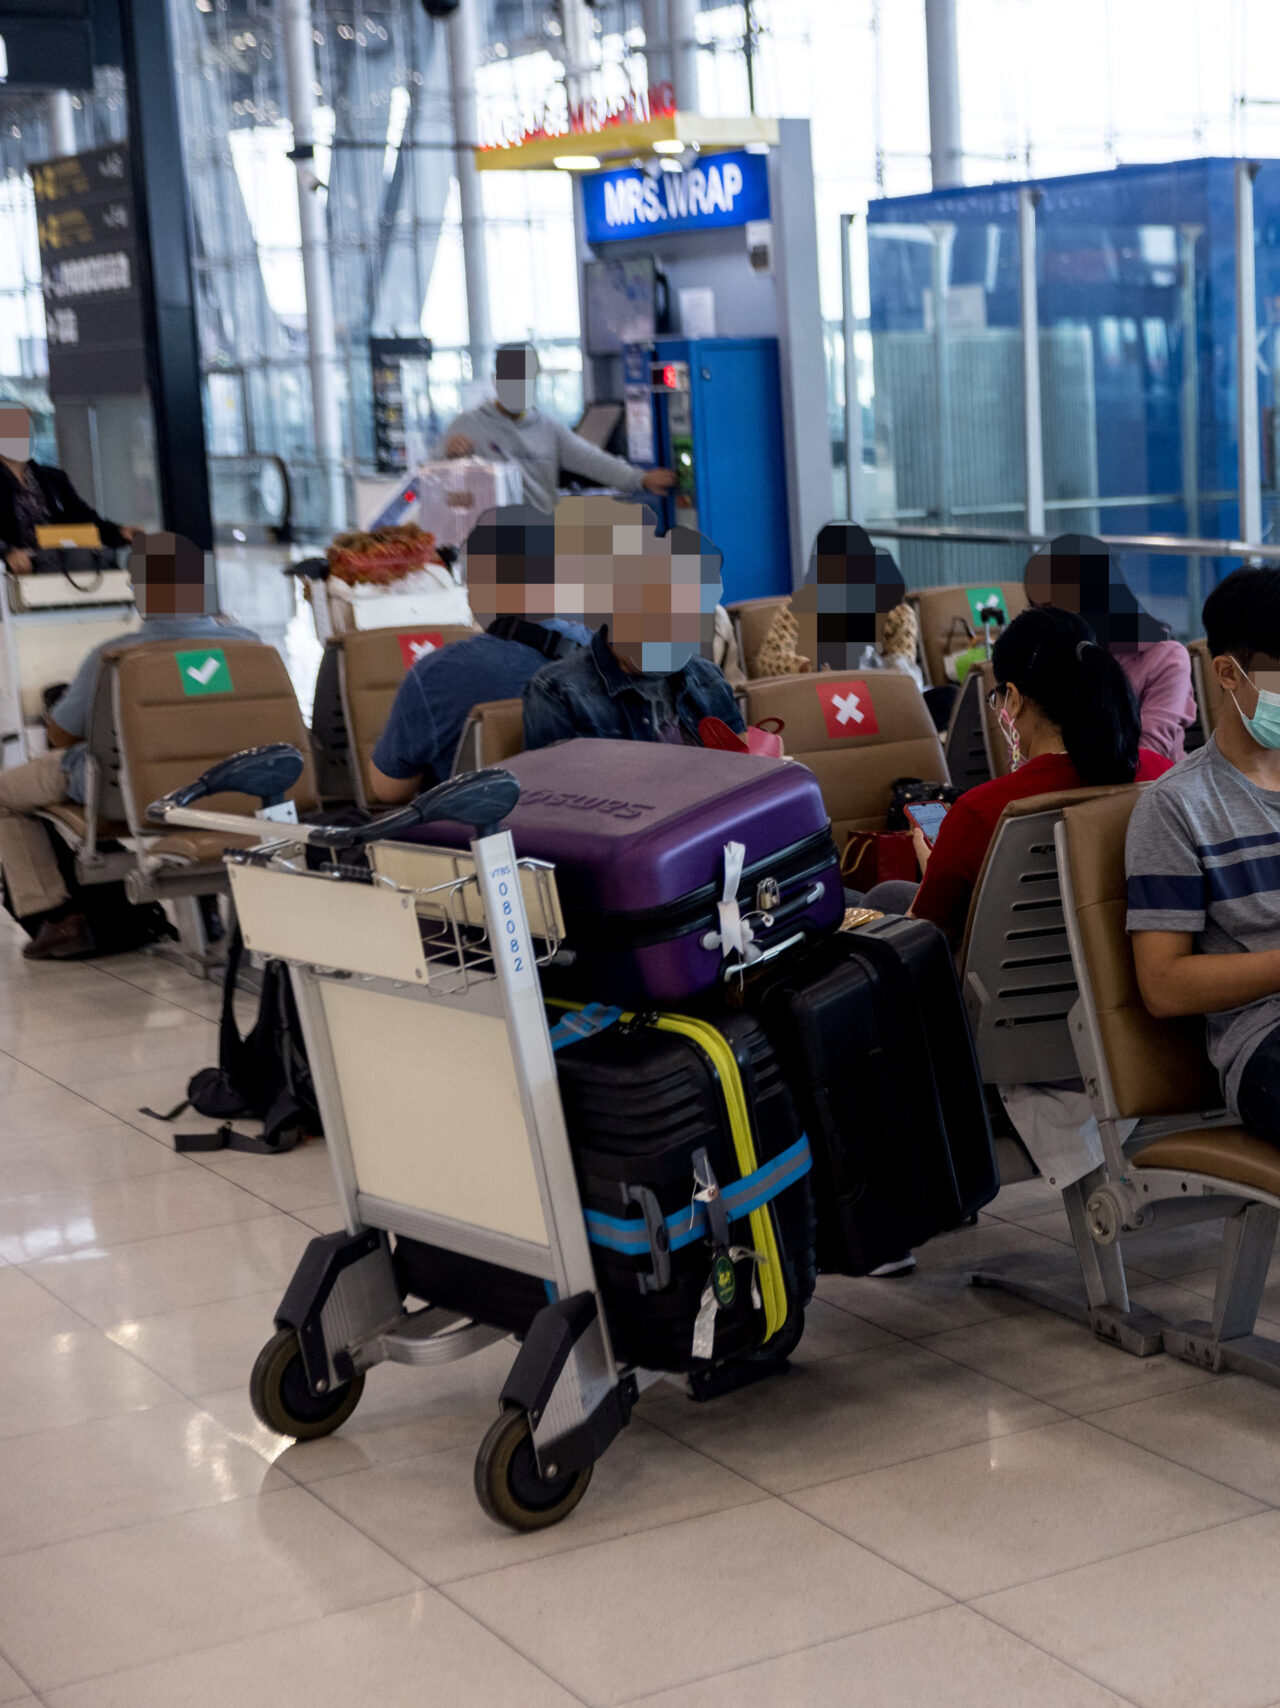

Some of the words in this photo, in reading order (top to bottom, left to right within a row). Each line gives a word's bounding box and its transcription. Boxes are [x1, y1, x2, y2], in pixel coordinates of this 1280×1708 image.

[604, 177, 666, 227] MRS.
[665, 162, 743, 217] WRAP
[498, 882, 523, 973] 08082
